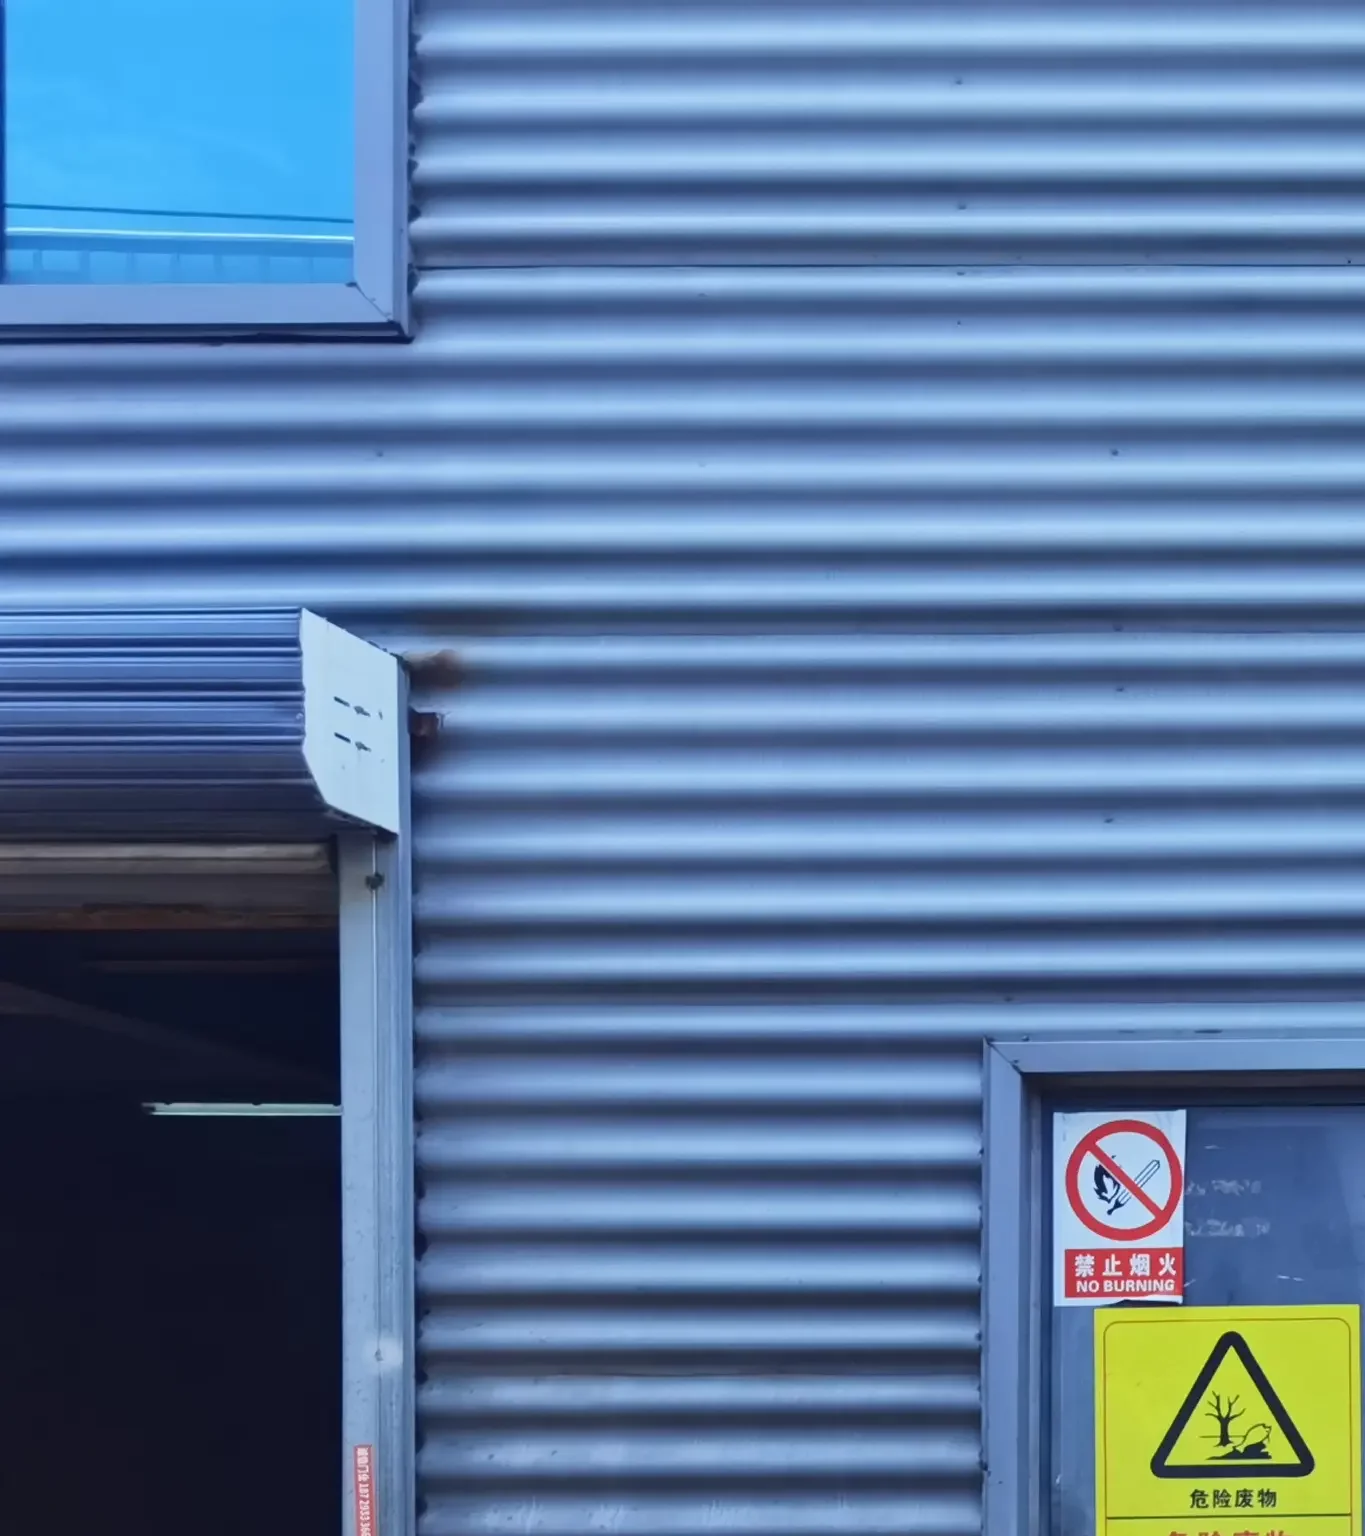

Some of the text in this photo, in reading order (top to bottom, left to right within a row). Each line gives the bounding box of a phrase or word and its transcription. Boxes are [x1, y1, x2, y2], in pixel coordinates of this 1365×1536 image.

[1074, 1253, 1176, 1278] 禁止烟火
[1076, 1279, 1175, 1293] NO BURNING
[1190, 1488, 1278, 1509] 危险废物
